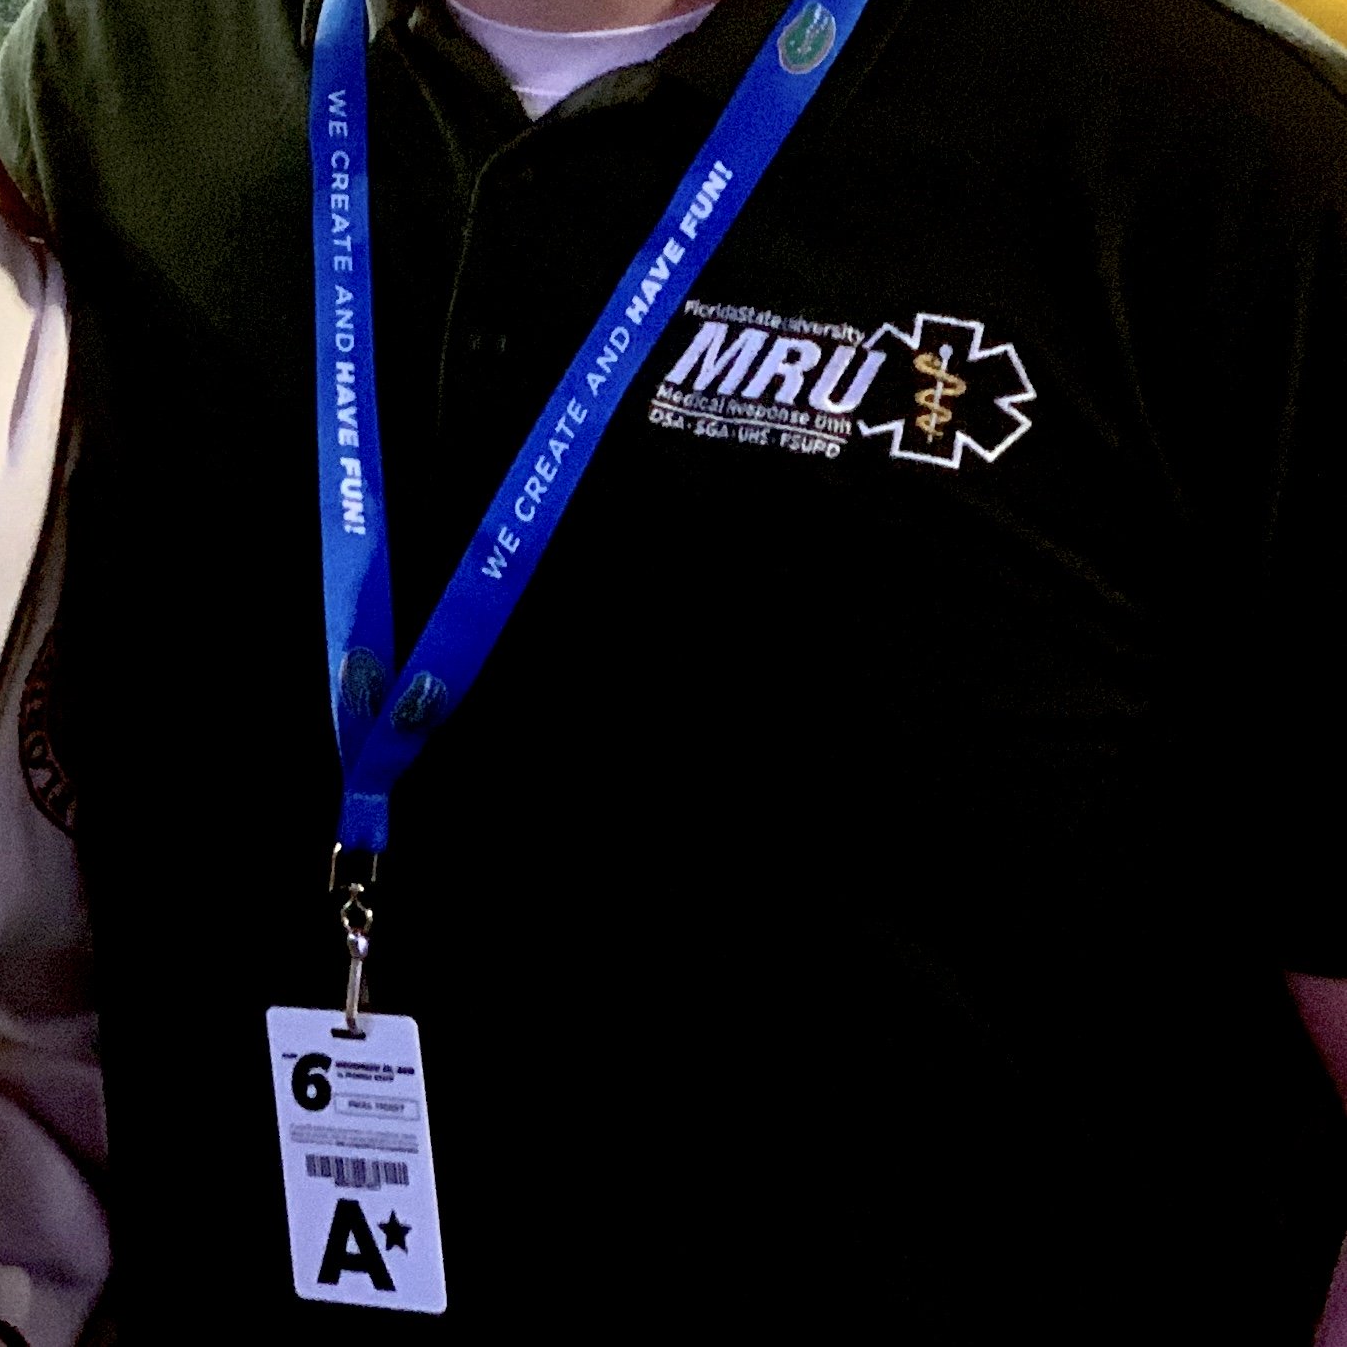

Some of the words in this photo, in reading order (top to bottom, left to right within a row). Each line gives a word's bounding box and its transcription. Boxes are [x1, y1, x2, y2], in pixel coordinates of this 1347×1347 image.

[327, 90, 349, 138] WE
[330, 150, 354, 272] CREATE
[334, 284, 355, 353] AND
[335, 361, 360, 448] HAVE
[481, 526, 521, 580] WE
[514, 397, 588, 522] CREATE
[585, 326, 630, 397] AND
[625, 237, 686, 326] HAVE
[679, 160, 734, 240] FUN!
[664, 321, 887, 414] MRU
[693, 419, 729, 439] SGA
[813, 412, 853, 436] Unit
[339, 456, 367, 536] FUN!
[291, 1052, 332, 1112] 6
[317, 1197, 396, 1292] A
